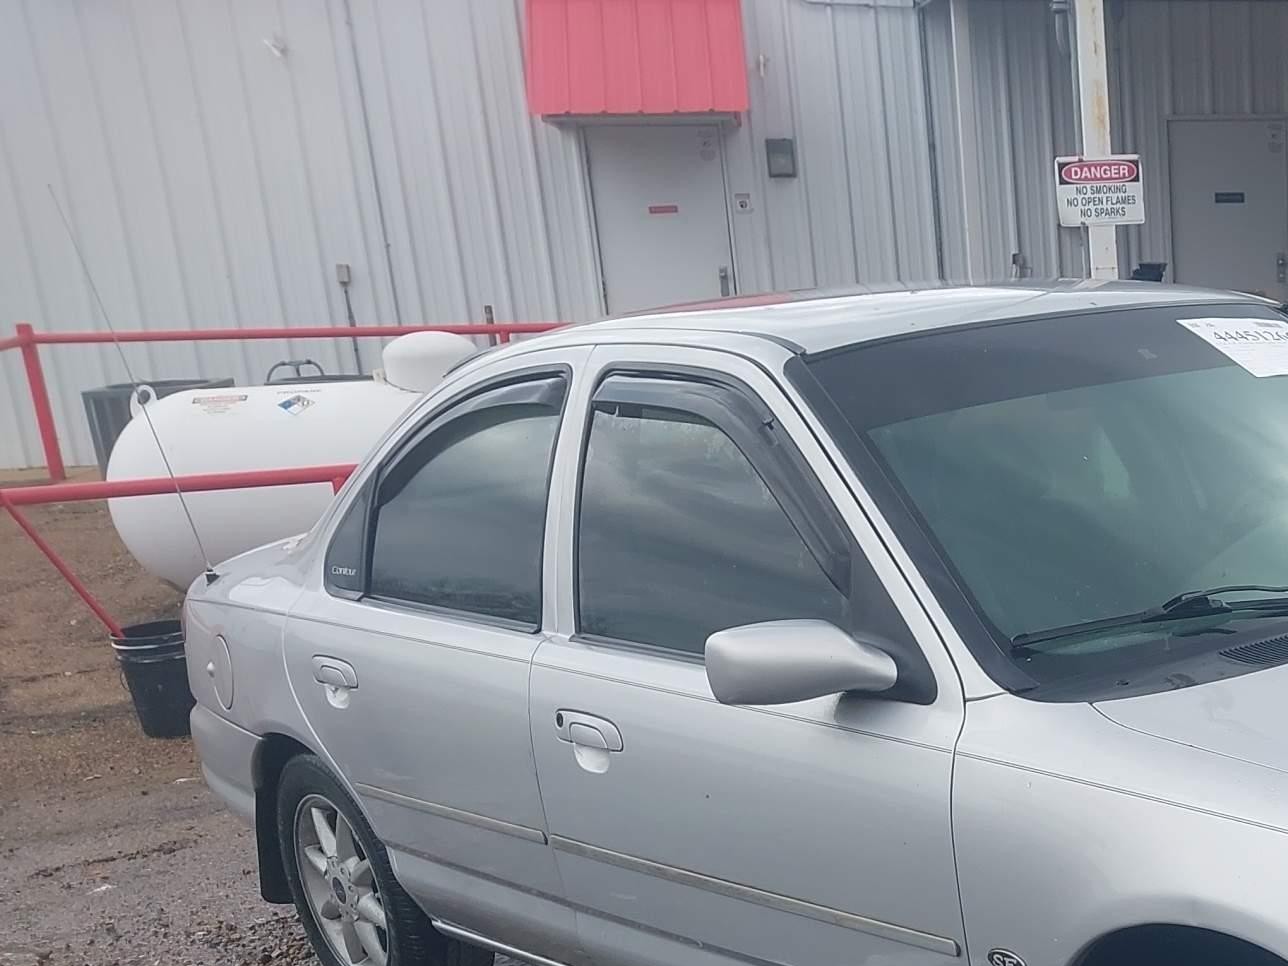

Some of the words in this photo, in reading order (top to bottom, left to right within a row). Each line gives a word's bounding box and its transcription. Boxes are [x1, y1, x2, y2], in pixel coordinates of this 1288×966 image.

[1071, 165, 1129, 179] DANGER
[1075, 185, 1088, 196] NO
[1090, 184, 1127, 195] SMOKING
[1066, 197, 1079, 207] NO
[1081, 196, 1104, 207] OPEN
[1106, 195, 1136, 206] FLAMES
[1080, 208, 1092, 218] NO
[1094, 207, 1126, 218] SPARKS
